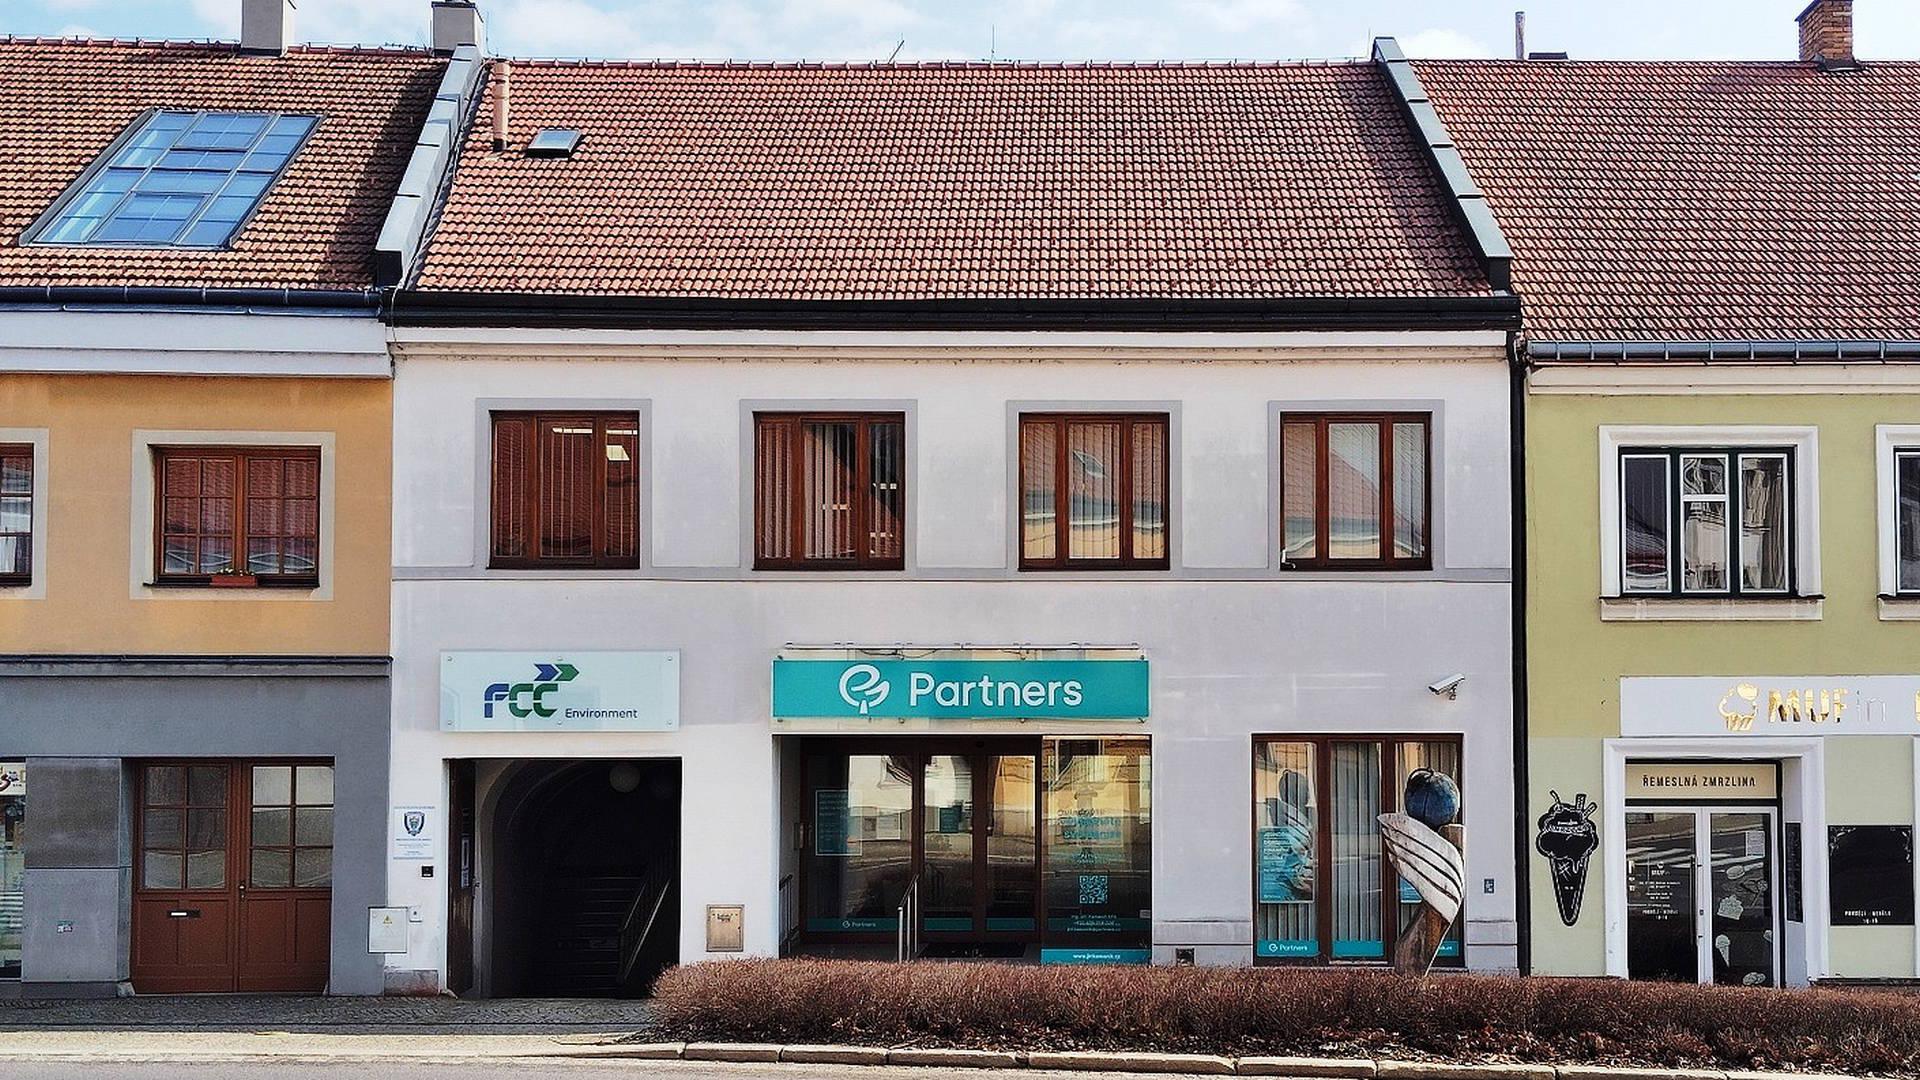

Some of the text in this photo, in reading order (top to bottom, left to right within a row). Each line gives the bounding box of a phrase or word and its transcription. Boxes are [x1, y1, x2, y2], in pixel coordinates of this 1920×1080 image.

[909, 671, 1084, 707] Partners
[484, 683, 559, 718] FCC
[564, 707, 638, 719] Environment
[1642, 774, 1756, 787] ŘEMESLNÁ ZMRZLINA
[1279, 943, 1308, 952] Partners
